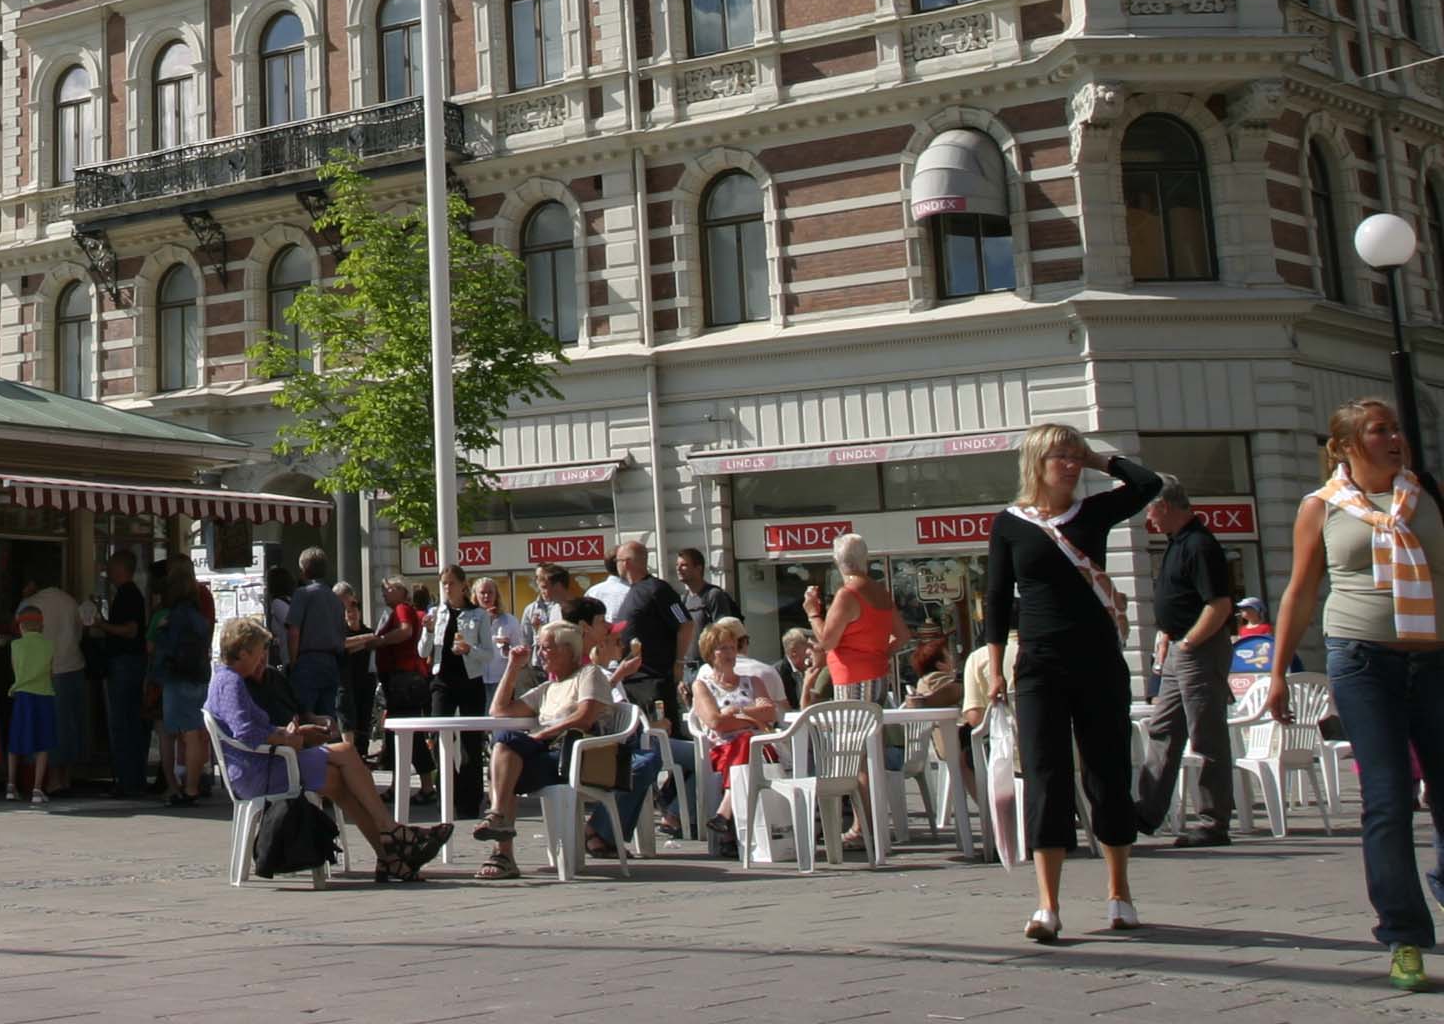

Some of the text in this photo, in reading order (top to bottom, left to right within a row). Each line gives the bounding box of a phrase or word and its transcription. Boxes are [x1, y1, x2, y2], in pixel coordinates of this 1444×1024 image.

[726, 437, 997, 470] LINDEX LINDEX LINDEX
[561, 470, 598, 481] LINDEX
[918, 518, 990, 539] LINDE
[529, 539, 600, 558] LINDEX
